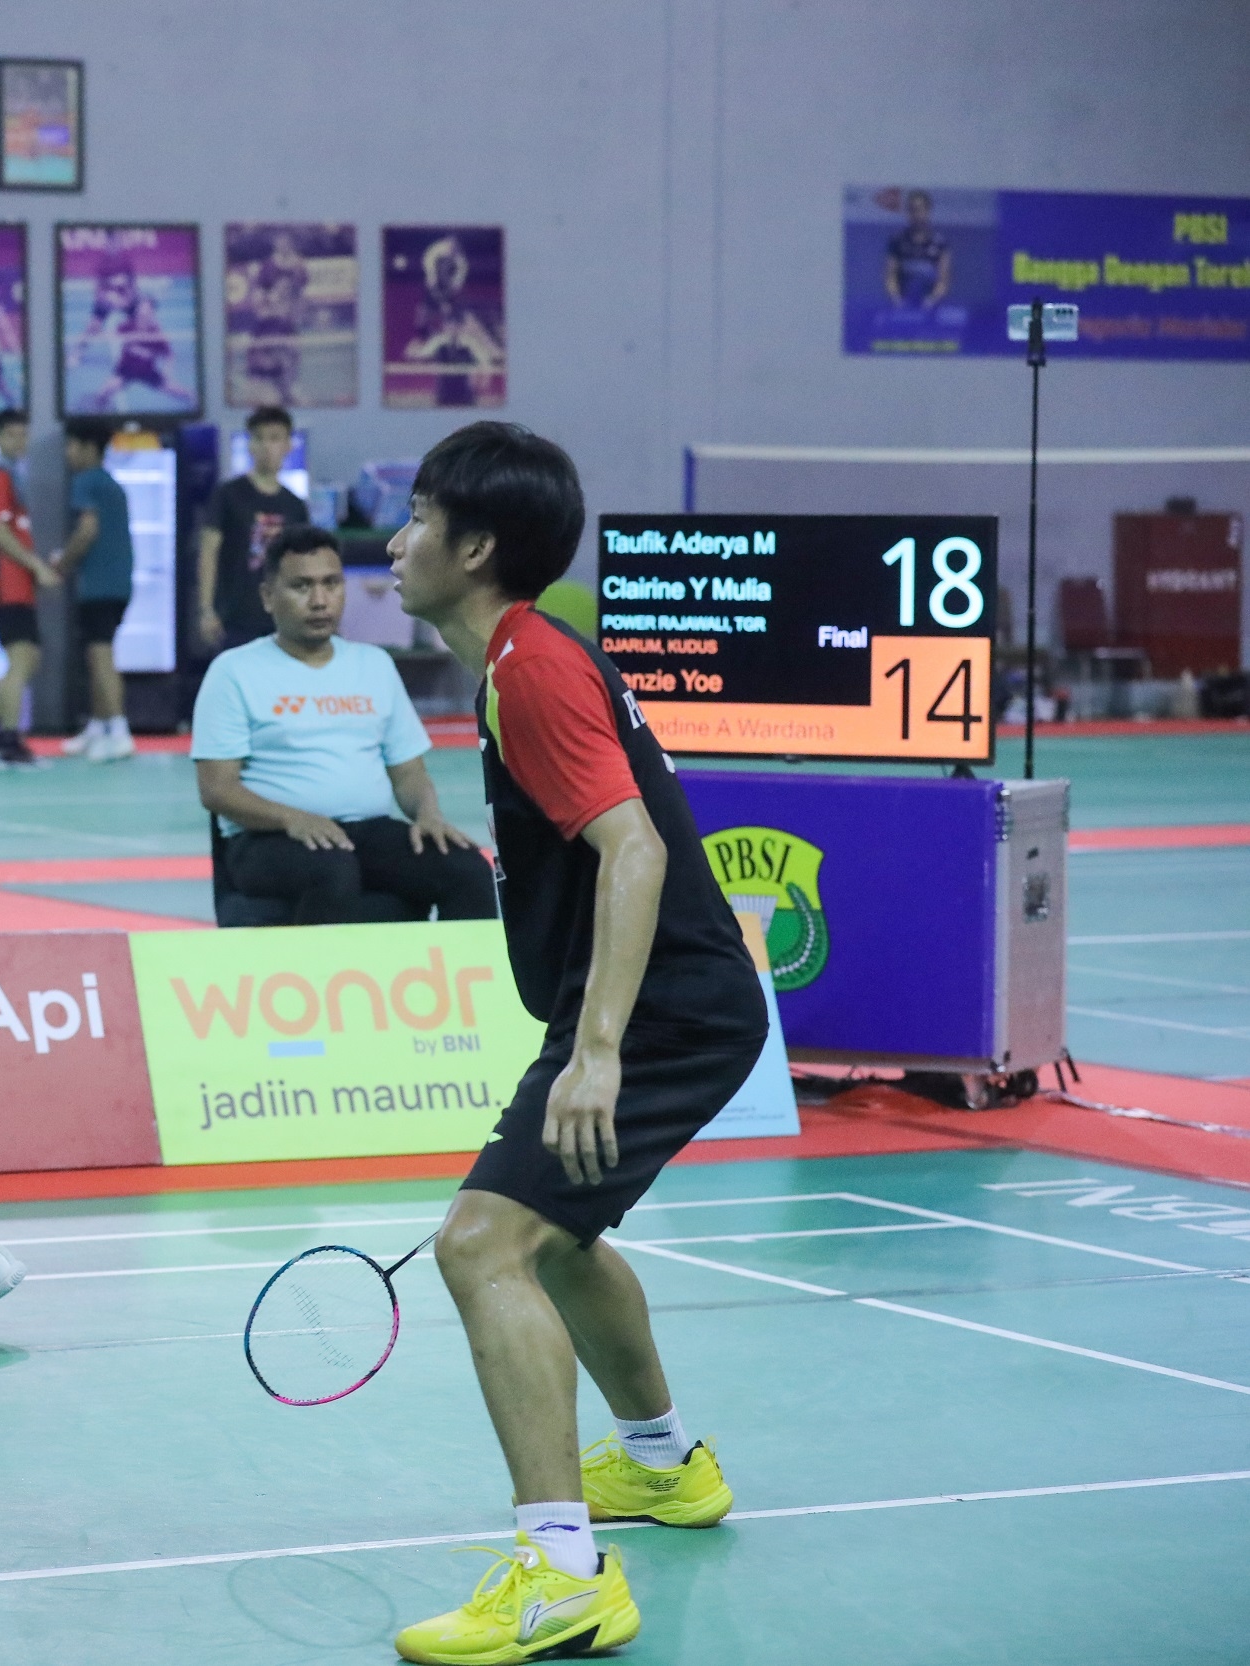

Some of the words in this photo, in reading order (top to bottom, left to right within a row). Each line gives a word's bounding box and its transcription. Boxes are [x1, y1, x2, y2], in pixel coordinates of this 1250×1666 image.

[605, 531, 667, 554] Taufik
[671, 532, 749, 560] Aderya
[754, 531, 776, 555] M
[602, 576, 686, 600] Clairine
[689, 577, 709, 600] Y
[712, 578, 771, 602] Mulia
[882, 536, 984, 628] 18
[602, 615, 657, 630] POWER
[658, 615, 732, 633] RAJAWALI,
[734, 616, 767, 632] TGR
[602, 638, 666, 655] DJARUM,
[668, 639, 718, 655] KUDUS
[818, 625, 868, 649] Final
[621, 668, 677, 692] enzie
[680, 668, 724, 693] Yoe
[315, 696, 375, 714] YONEX
[884, 657, 983, 742] 14
[652, 717, 710, 738] adine
[716, 718, 732, 738] A
[734, 718, 835, 741] Wardana
[714, 837, 793, 884] PBSI
[169, 946, 494, 1040] wondr
[413, 1036, 437, 1057] by
[442, 1035, 481, 1053] BNI
[200, 1080, 316, 1129] jadiin
[332, 1081, 502, 1113] maumu.
